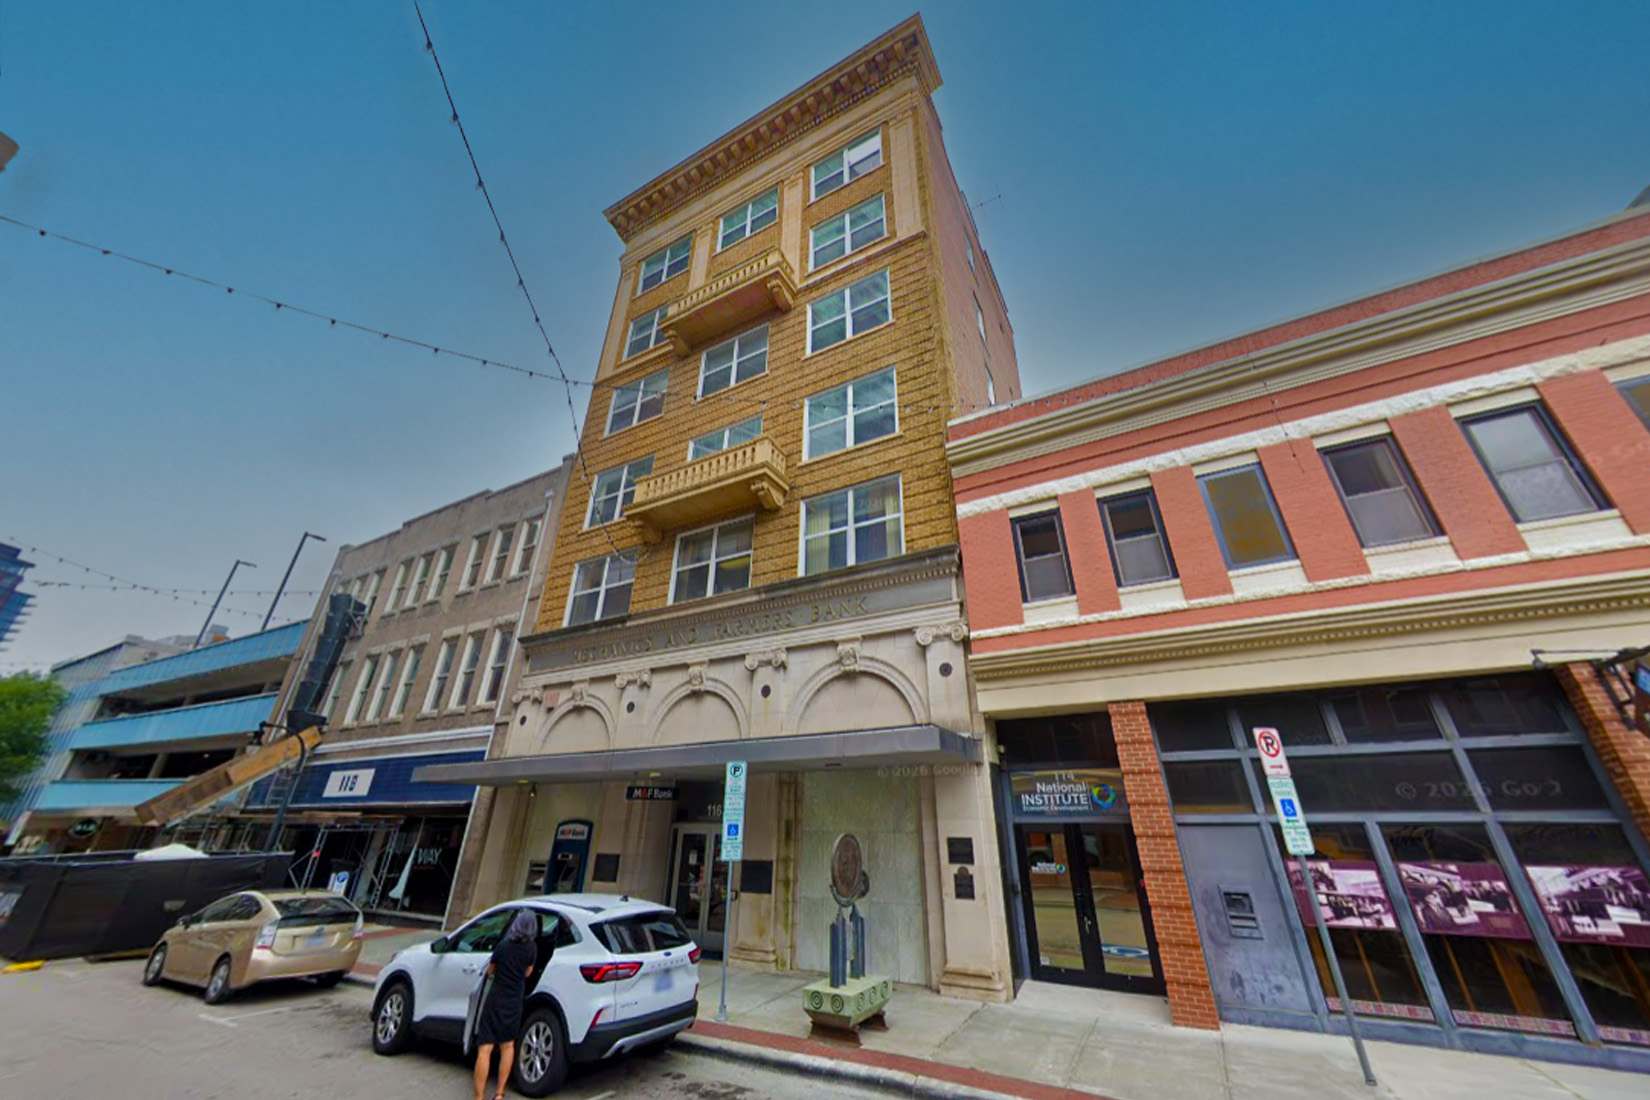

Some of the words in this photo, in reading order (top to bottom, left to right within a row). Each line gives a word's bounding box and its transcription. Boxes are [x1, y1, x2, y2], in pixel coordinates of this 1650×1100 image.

[665, 627, 699, 648] AND
[713, 613, 794, 639] FARMERS
[811, 598, 869, 622] BANK
[653, 788, 673, 799] Bank
[1036, 781, 1087, 794] National
[1021, 793, 1089, 805] INSTITUTE
[707, 803, 722, 817] 116
